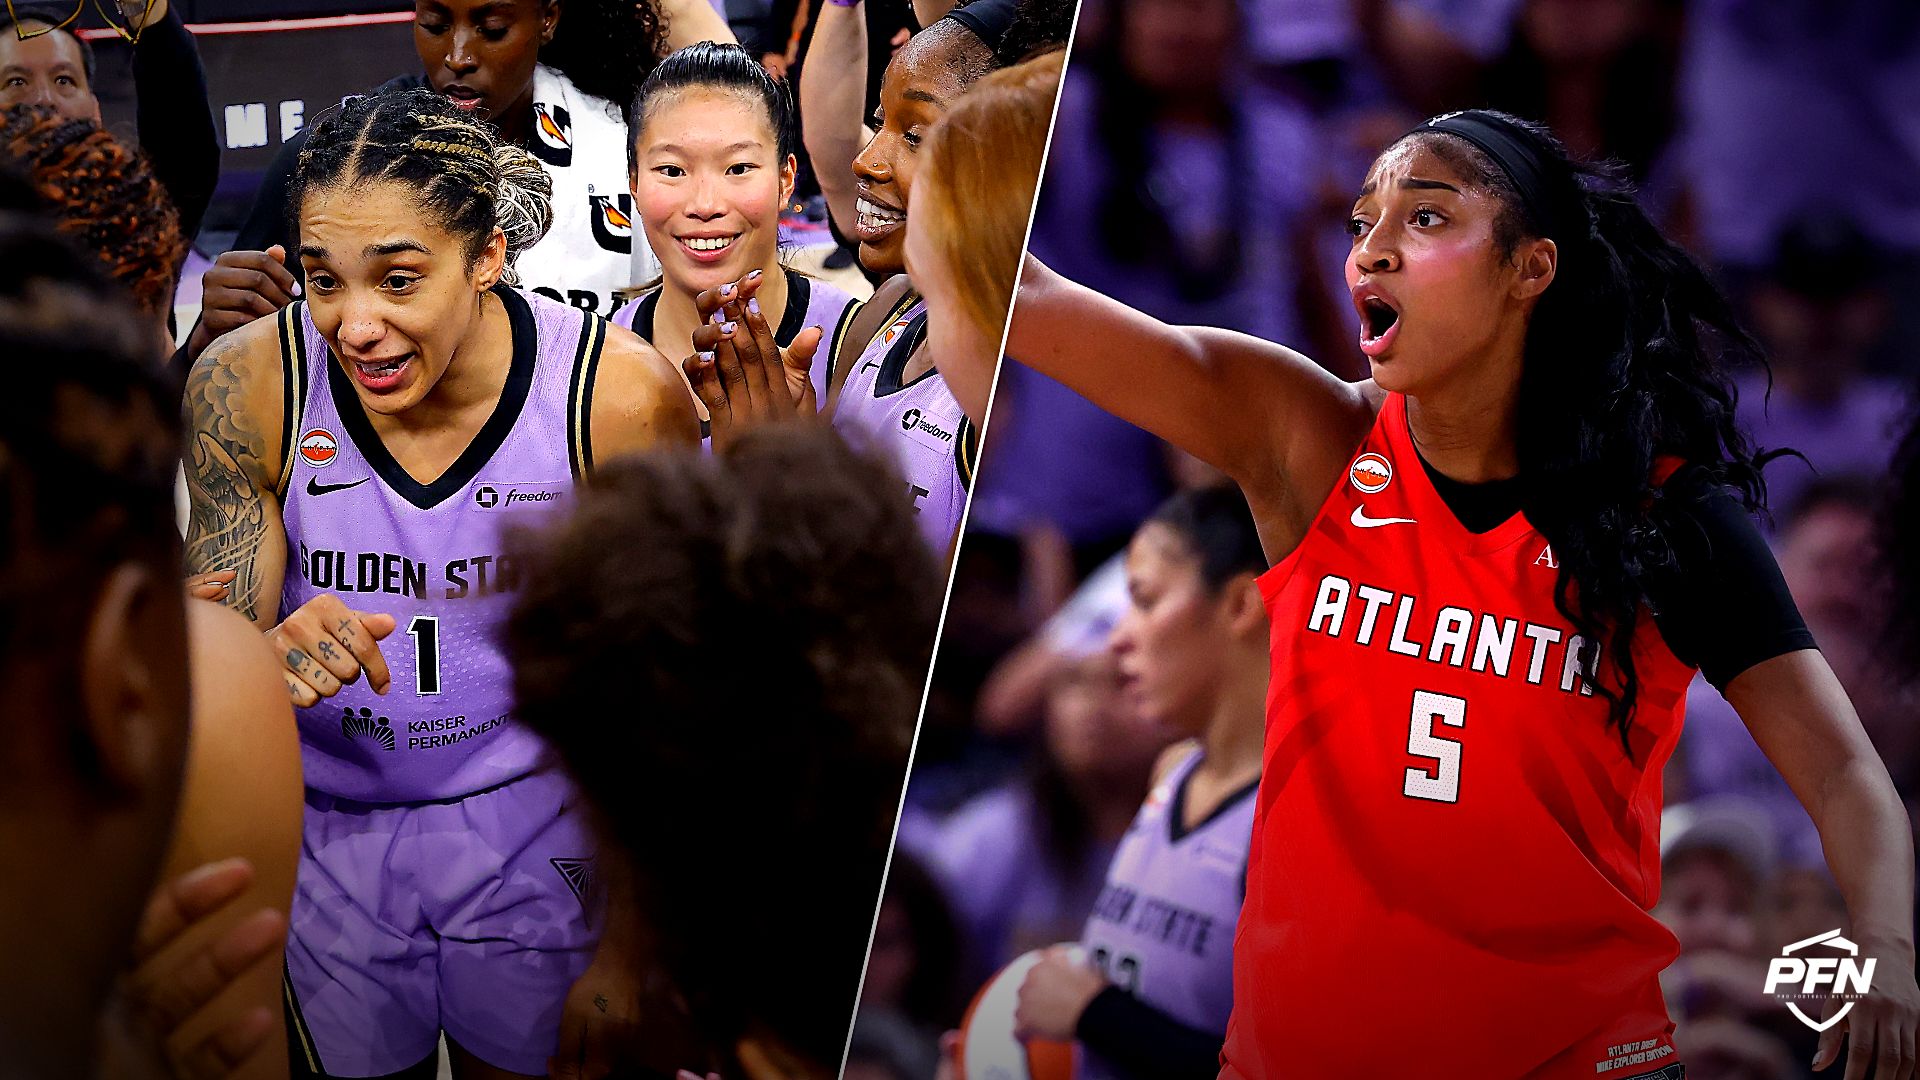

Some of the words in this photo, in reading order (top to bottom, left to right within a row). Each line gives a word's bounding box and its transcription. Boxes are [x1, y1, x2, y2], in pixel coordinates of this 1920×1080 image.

[918, 415, 953, 442] reedom
[504, 488, 563, 508] freedom
[445, 555, 521, 600] STA
[1307, 574, 1601, 697] ATLANTA
[405, 615, 441, 697] 1
[408, 715, 466, 734] KAISER
[408, 715, 507, 751] PERMANENT
[1403, 689, 1467, 804] 5
[1608, 1042, 1641, 1057] ATLANTA
